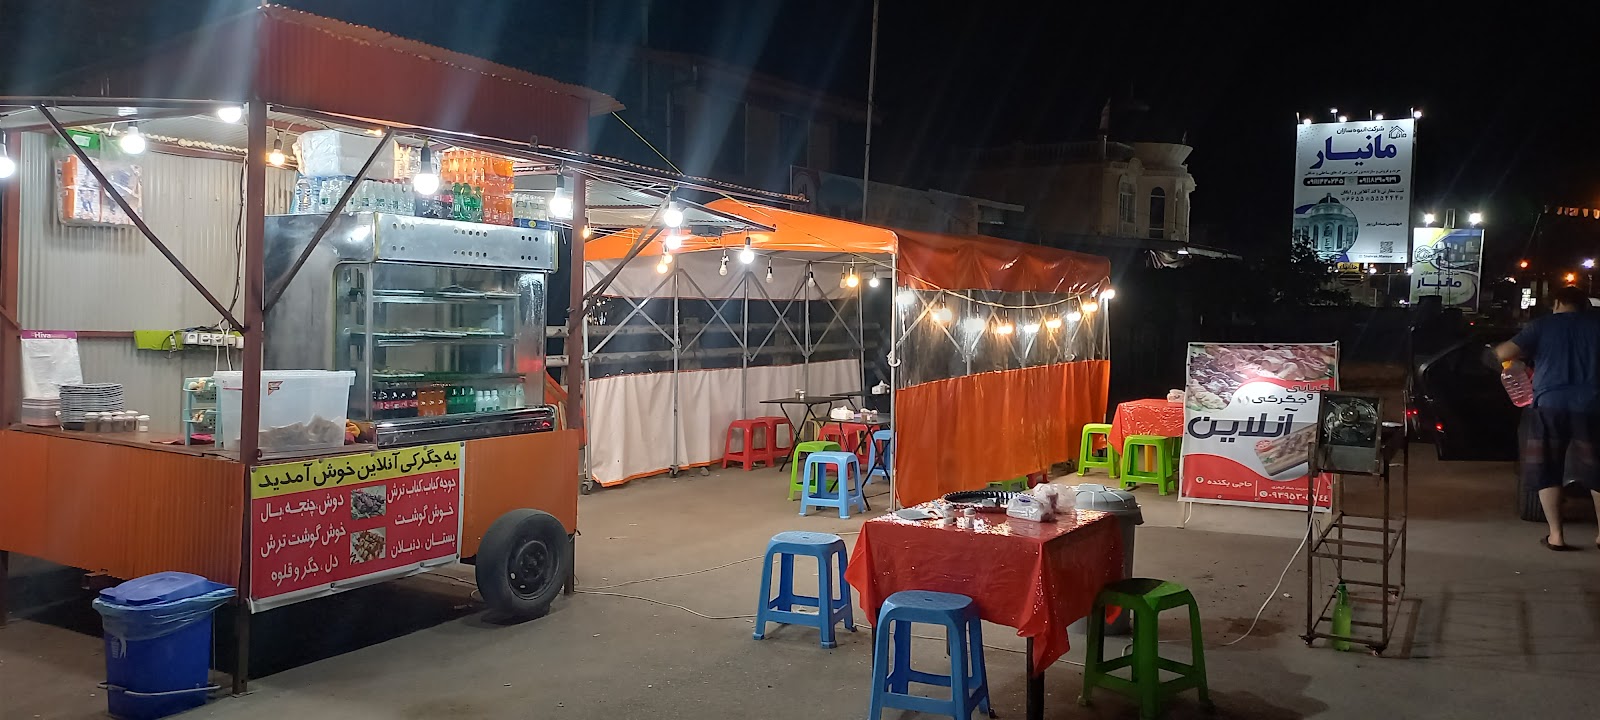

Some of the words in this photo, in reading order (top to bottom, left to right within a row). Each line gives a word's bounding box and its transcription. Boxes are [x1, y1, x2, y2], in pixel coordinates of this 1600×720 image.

[1309, 133, 1397, 169] مانیار
[1187, 408, 1299, 443] آنلاین
[357, 452, 401, 480] آنلاین
[400, 449, 442, 472] جگرکی
[444, 450, 457, 461] به
[258, 463, 312, 491] آمدید
[313, 462, 355, 486] خوش
[440, 477, 456, 493] جوجه
[387, 483, 406, 504] ترش
[395, 504, 428, 526] گوشت
[428, 502, 454, 524] خوش
[288, 523, 322, 549] گوشت
[321, 521, 346, 546] خوش
[424, 532, 456, 550] پستان
[260, 534, 287, 558] ترش
[391, 539, 421, 558] دنبلان
[271, 562, 293, 587] قلوه
[300, 556, 319, 580] جگر
[324, 554, 339, 573] دل
